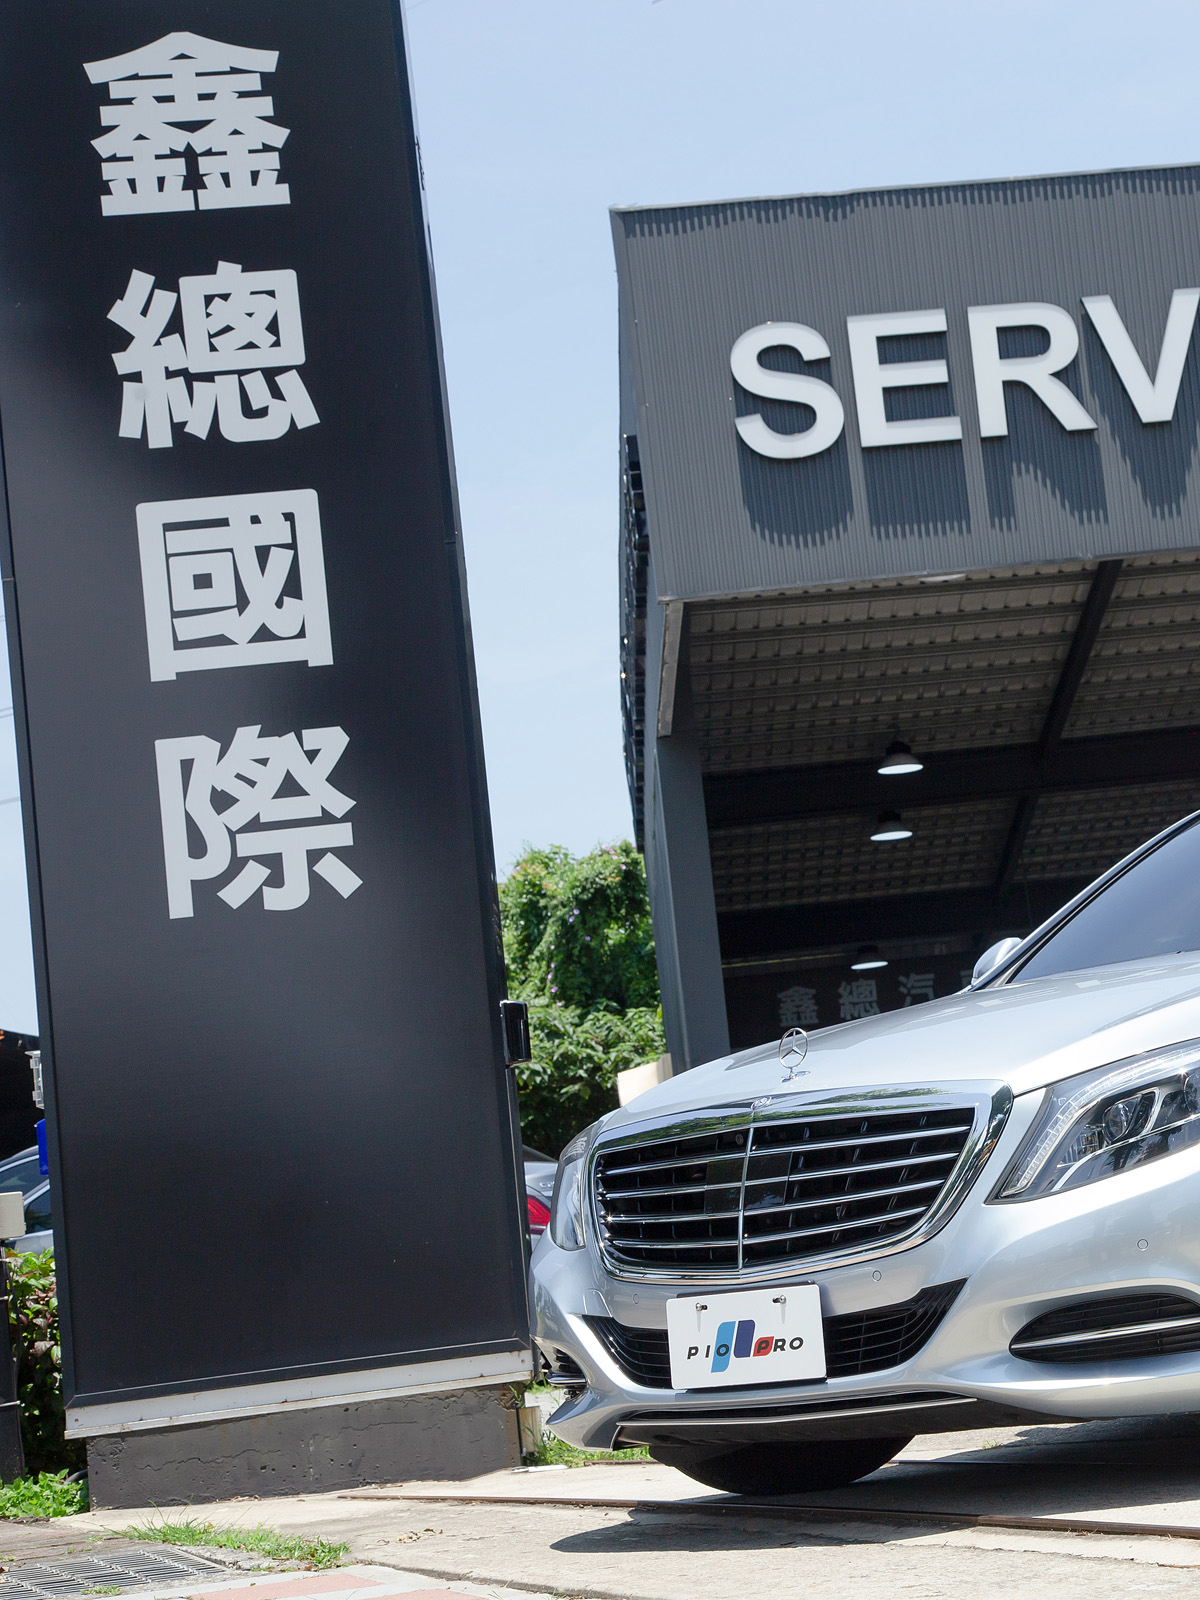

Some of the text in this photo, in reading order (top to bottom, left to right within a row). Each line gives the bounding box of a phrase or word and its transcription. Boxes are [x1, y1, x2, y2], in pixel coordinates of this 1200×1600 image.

[83, 31, 363, 920] 鑫總國際
[776, 968, 973, 1028] 鑫總汽
